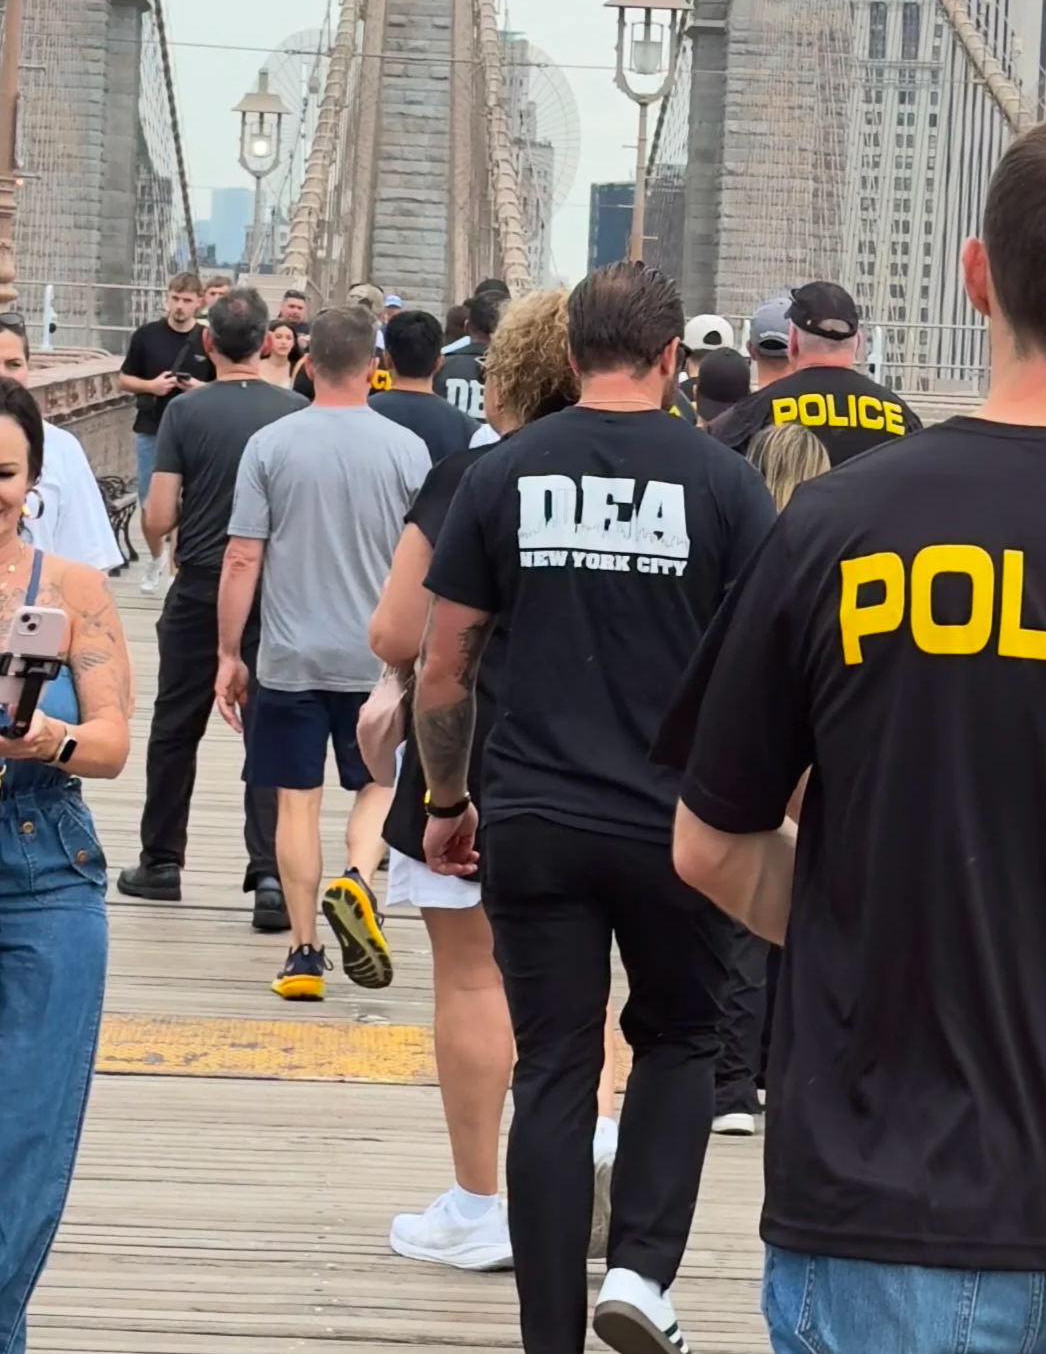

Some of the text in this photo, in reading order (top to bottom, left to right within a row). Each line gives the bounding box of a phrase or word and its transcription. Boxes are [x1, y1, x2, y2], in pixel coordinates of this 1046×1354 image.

[771, 393, 906, 436] POLICE
[517, 474, 691, 559] DEA
[519, 550, 688, 577] NEW YORK CITY
